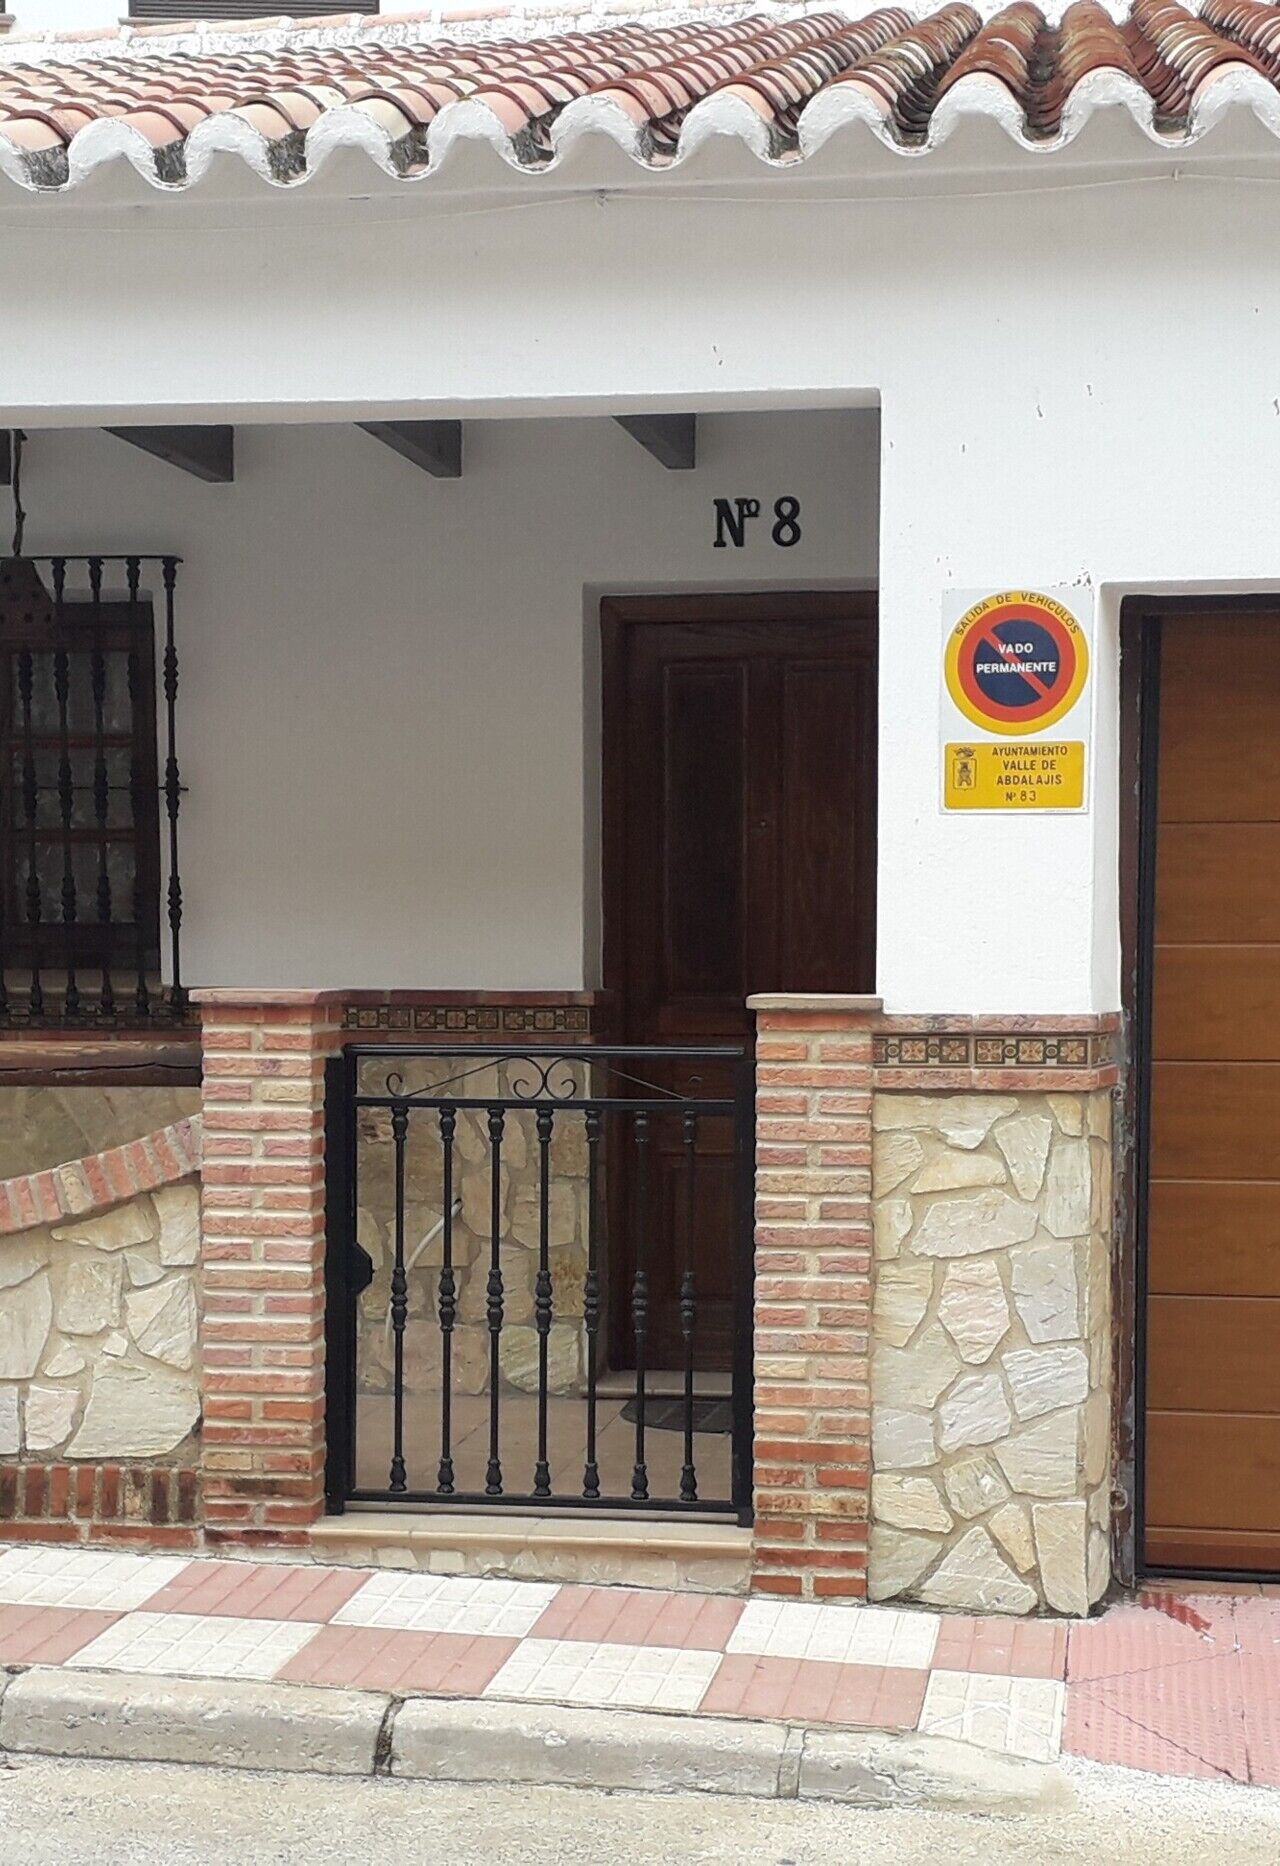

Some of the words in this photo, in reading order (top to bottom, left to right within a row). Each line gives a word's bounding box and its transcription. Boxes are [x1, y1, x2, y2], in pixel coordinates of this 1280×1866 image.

[772, 496, 801, 547] 8
[955, 603, 990, 635] SALIDA
[996, 593, 1012, 604] DE
[1021, 592, 1081, 635] VEHICULOS
[998, 643, 1034, 653] VADO
[976, 661, 1056, 674] PERMANENTE
[992, 746, 1068, 756] AYUNTAMIENTO
[1003, 760, 1036, 771] VALLE
[1042, 759, 1056, 771] DE
[996, 774, 1062, 786] ABDALAJIS
[1020, 791, 1037, 801] 83
